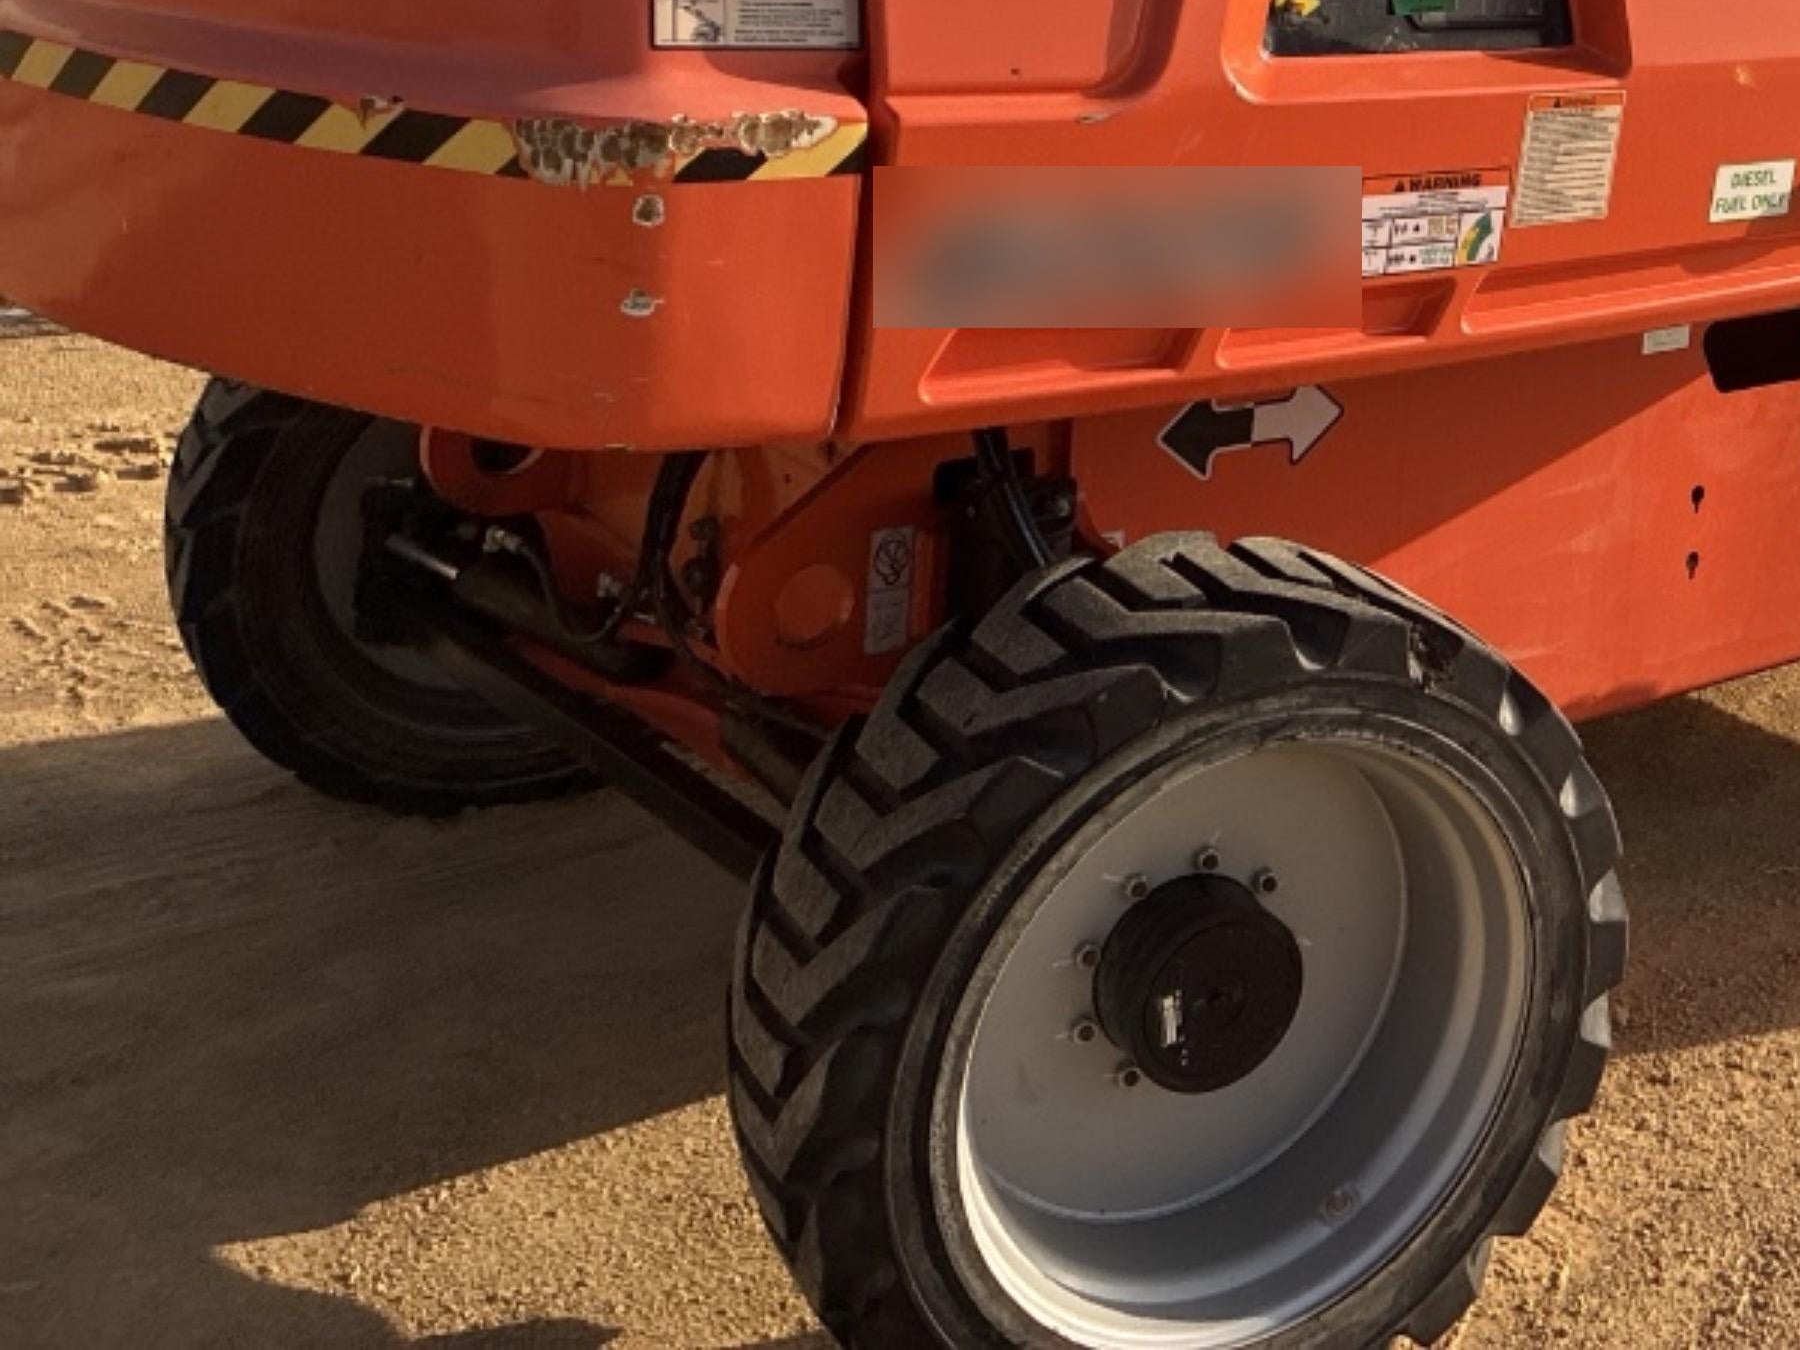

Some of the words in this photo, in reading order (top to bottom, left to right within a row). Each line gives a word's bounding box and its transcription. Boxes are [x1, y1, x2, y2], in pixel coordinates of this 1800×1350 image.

[1409, 173, 1482, 192] WARNING
[1731, 169, 1776, 189] DIESEL
[1715, 197, 1747, 214] FUEL
[1751, 193, 1786, 211] ONLY
